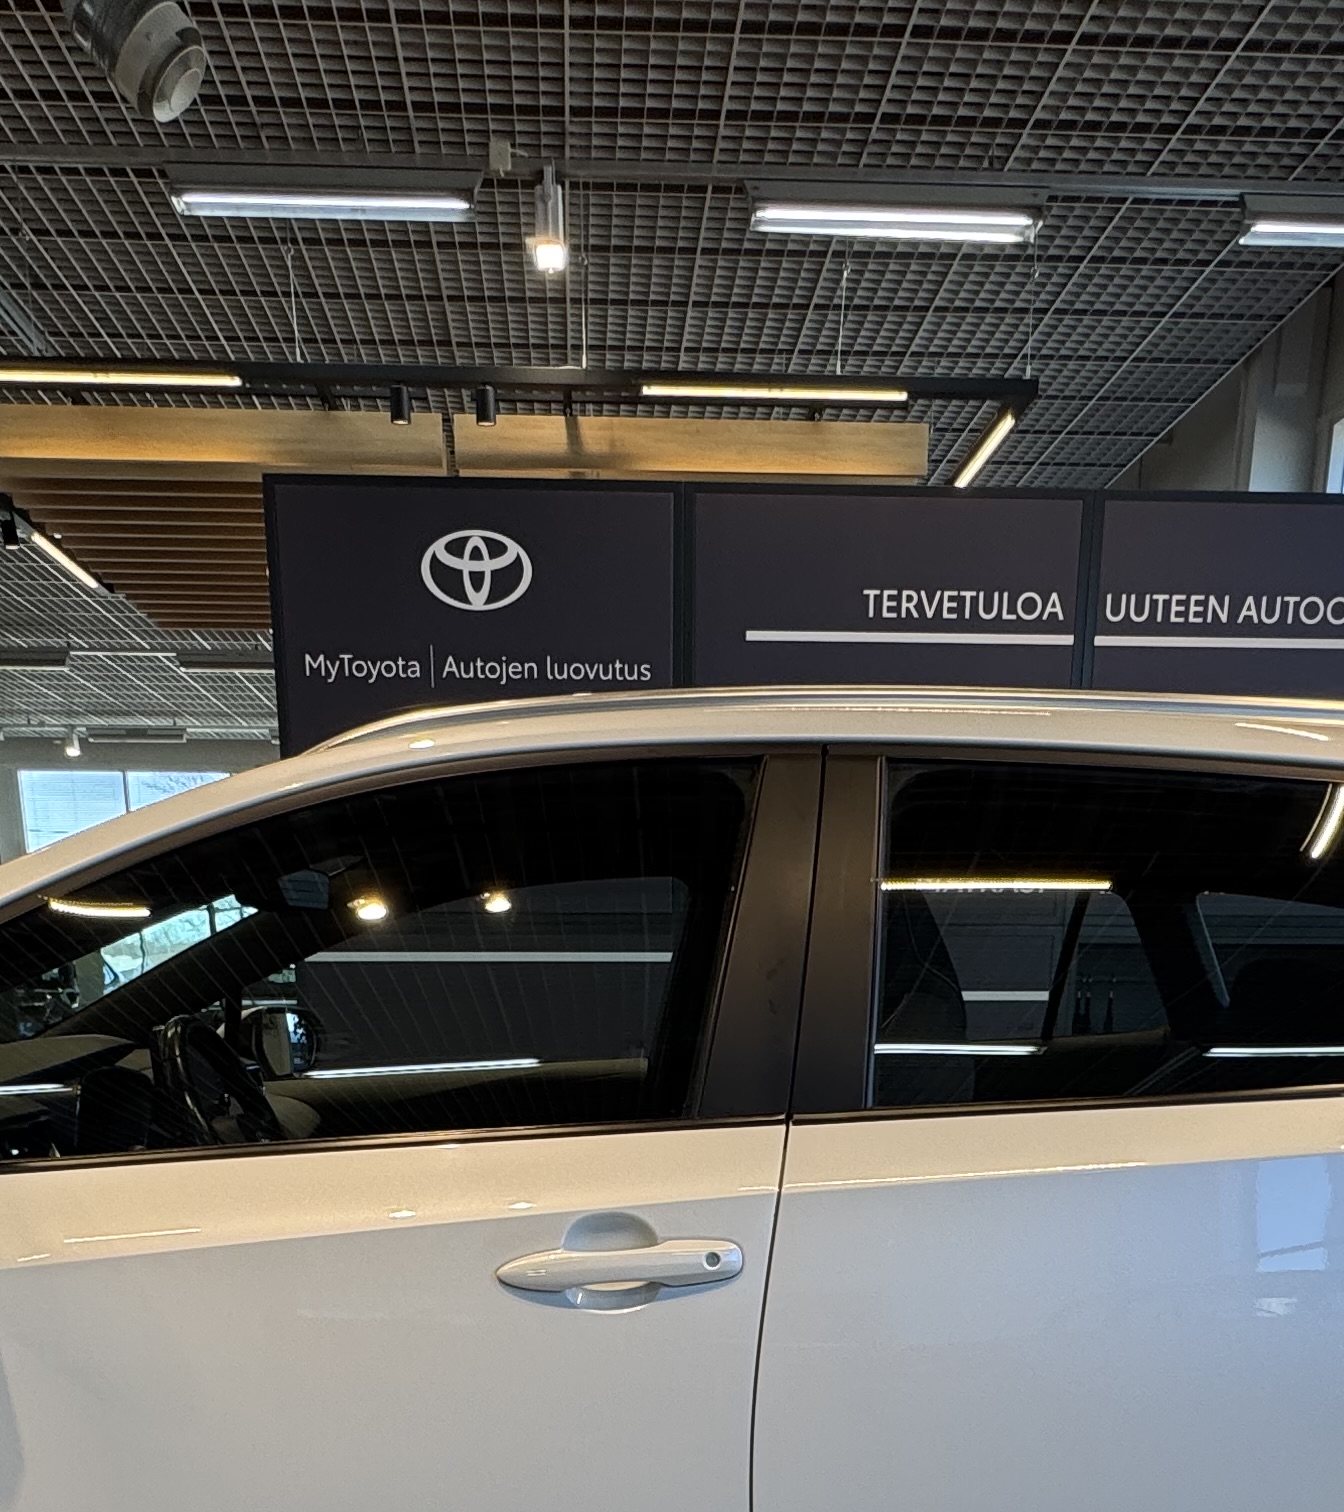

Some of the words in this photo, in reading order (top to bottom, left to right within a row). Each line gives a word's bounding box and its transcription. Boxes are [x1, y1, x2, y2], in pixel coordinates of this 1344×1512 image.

[863, 588, 1064, 621] TERVETULOA
[1105, 593, 1230, 624] UUTEEN
[304, 653, 421, 684] MyToyota
[442, 655, 538, 685] Autojen
[546, 655, 652, 682] luovutus
